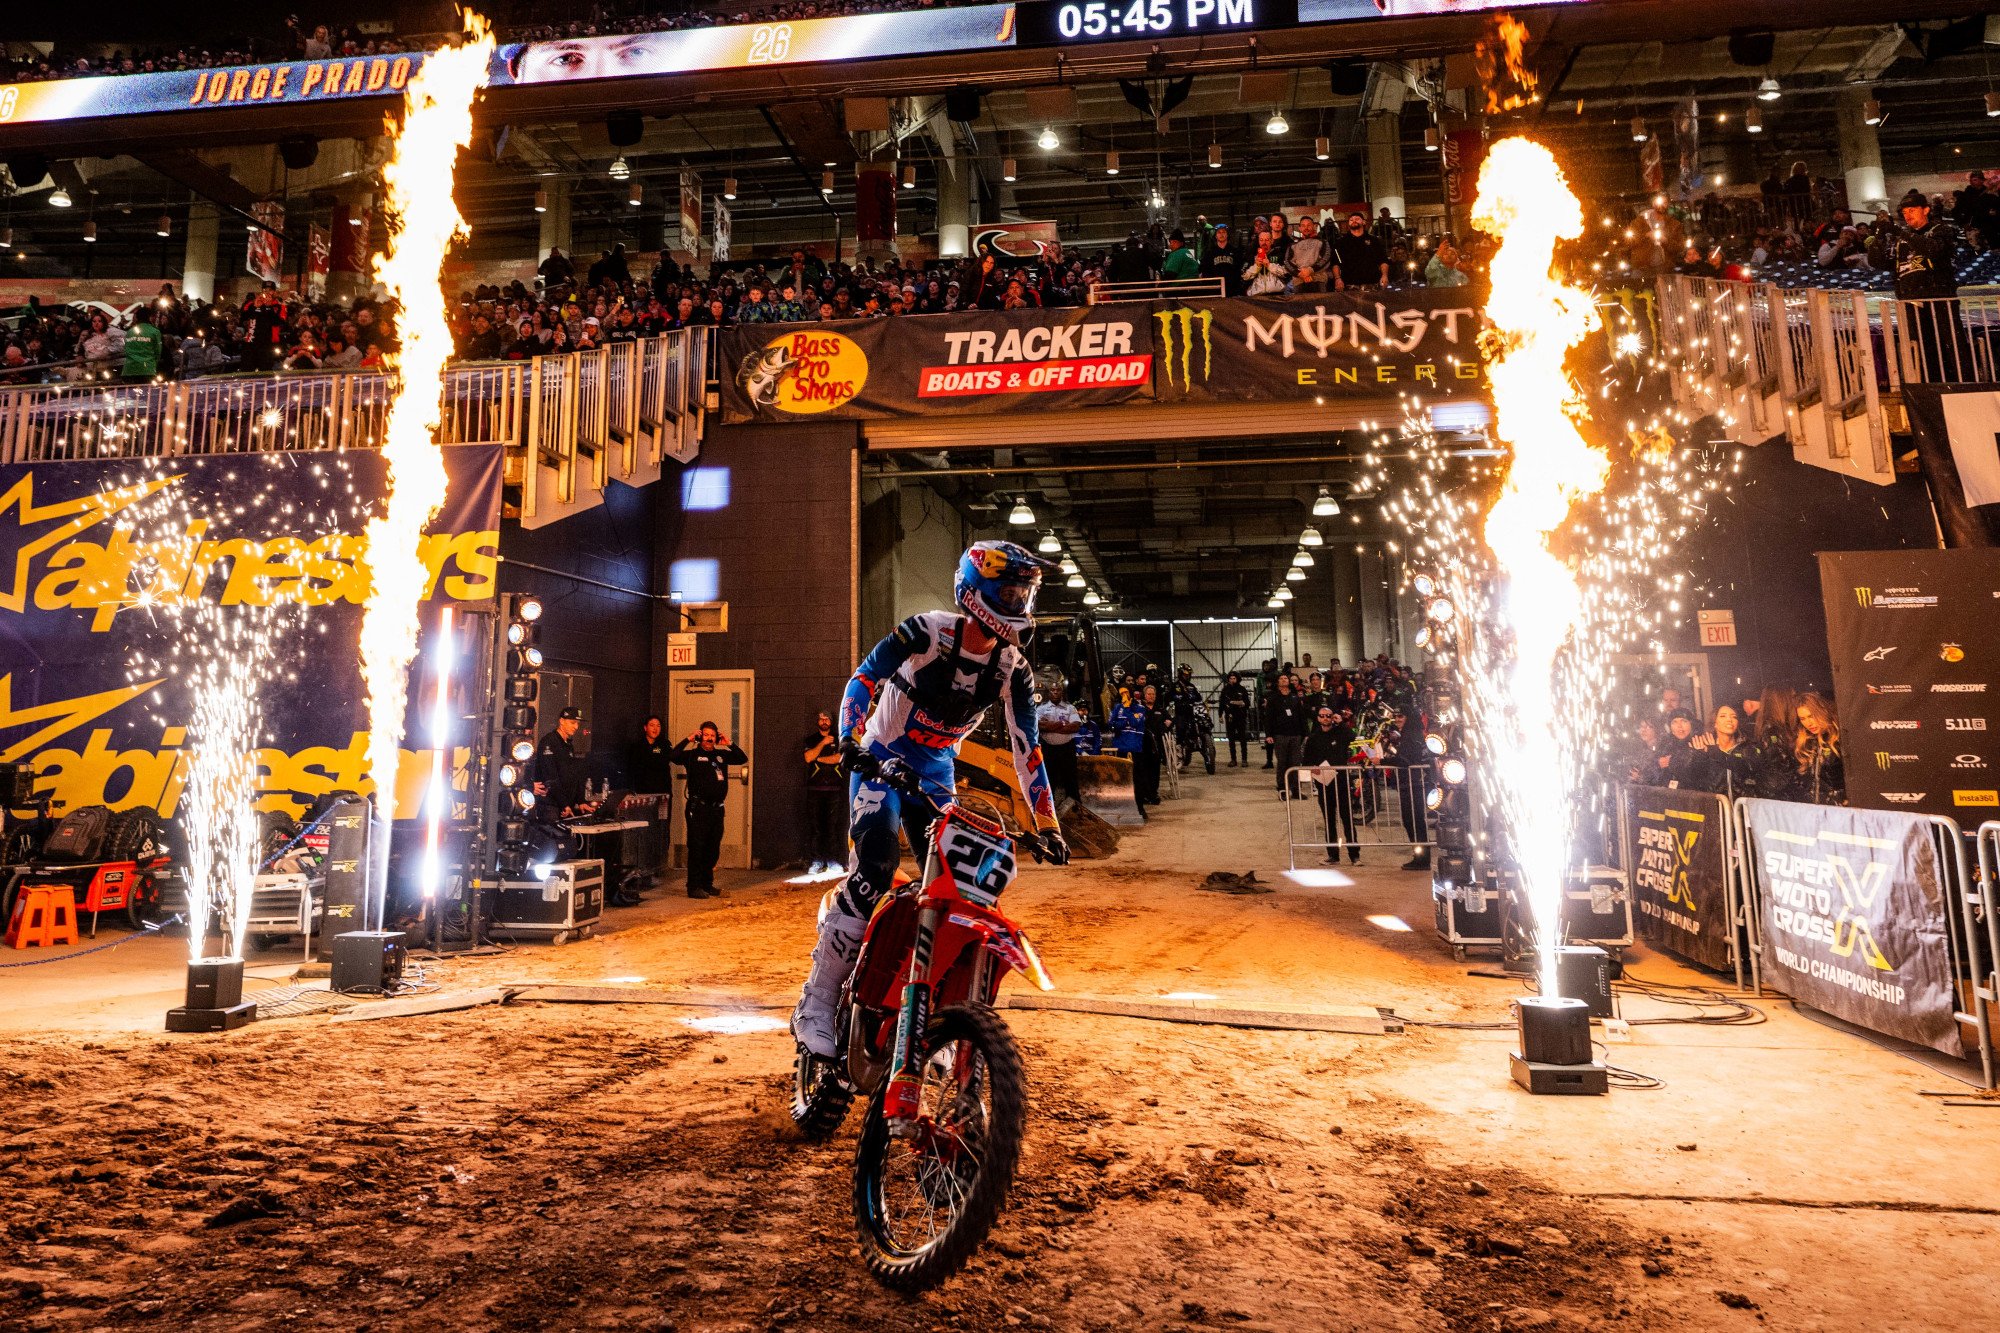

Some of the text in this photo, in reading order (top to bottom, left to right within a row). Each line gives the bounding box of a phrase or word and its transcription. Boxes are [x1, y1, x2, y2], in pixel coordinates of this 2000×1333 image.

[1057, 0, 1255, 37] 05:45 PM
[748, 25, 792, 62] 26
[189, 57, 411, 104] JORGE PRADO
[0, 86, 19, 122] 6
[791, 333, 841, 358] Bass
[943, 321, 1133, 365] TRACKER
[1244, 303, 1490, 359] MONST
[793, 356, 831, 379] Pro
[926, 361, 1146, 392] BOATS & OFF ROAD
[1296, 361, 1479, 386] ENERG
[791, 376, 854, 404] Shops
[1707, 626, 1730, 643] EXIT
[672, 647, 692, 663] EXIT
[1930, 684, 1988, 693] PROGRESSIVE
[1945, 718, 1972, 731] 5.11
[951, 833, 1014, 897] 26
[1636, 867, 1673, 895] CROSS
[1764, 850, 1835, 888] SUPER
[851, 871, 883, 905] FOX
[1770, 878, 1831, 916] MOTO
[1772, 905, 1836, 945] CROSS
[1774, 945, 1905, 1006] WORLD CHAMPIONSHIP
[911, 1001, 929, 1072] DUNP
